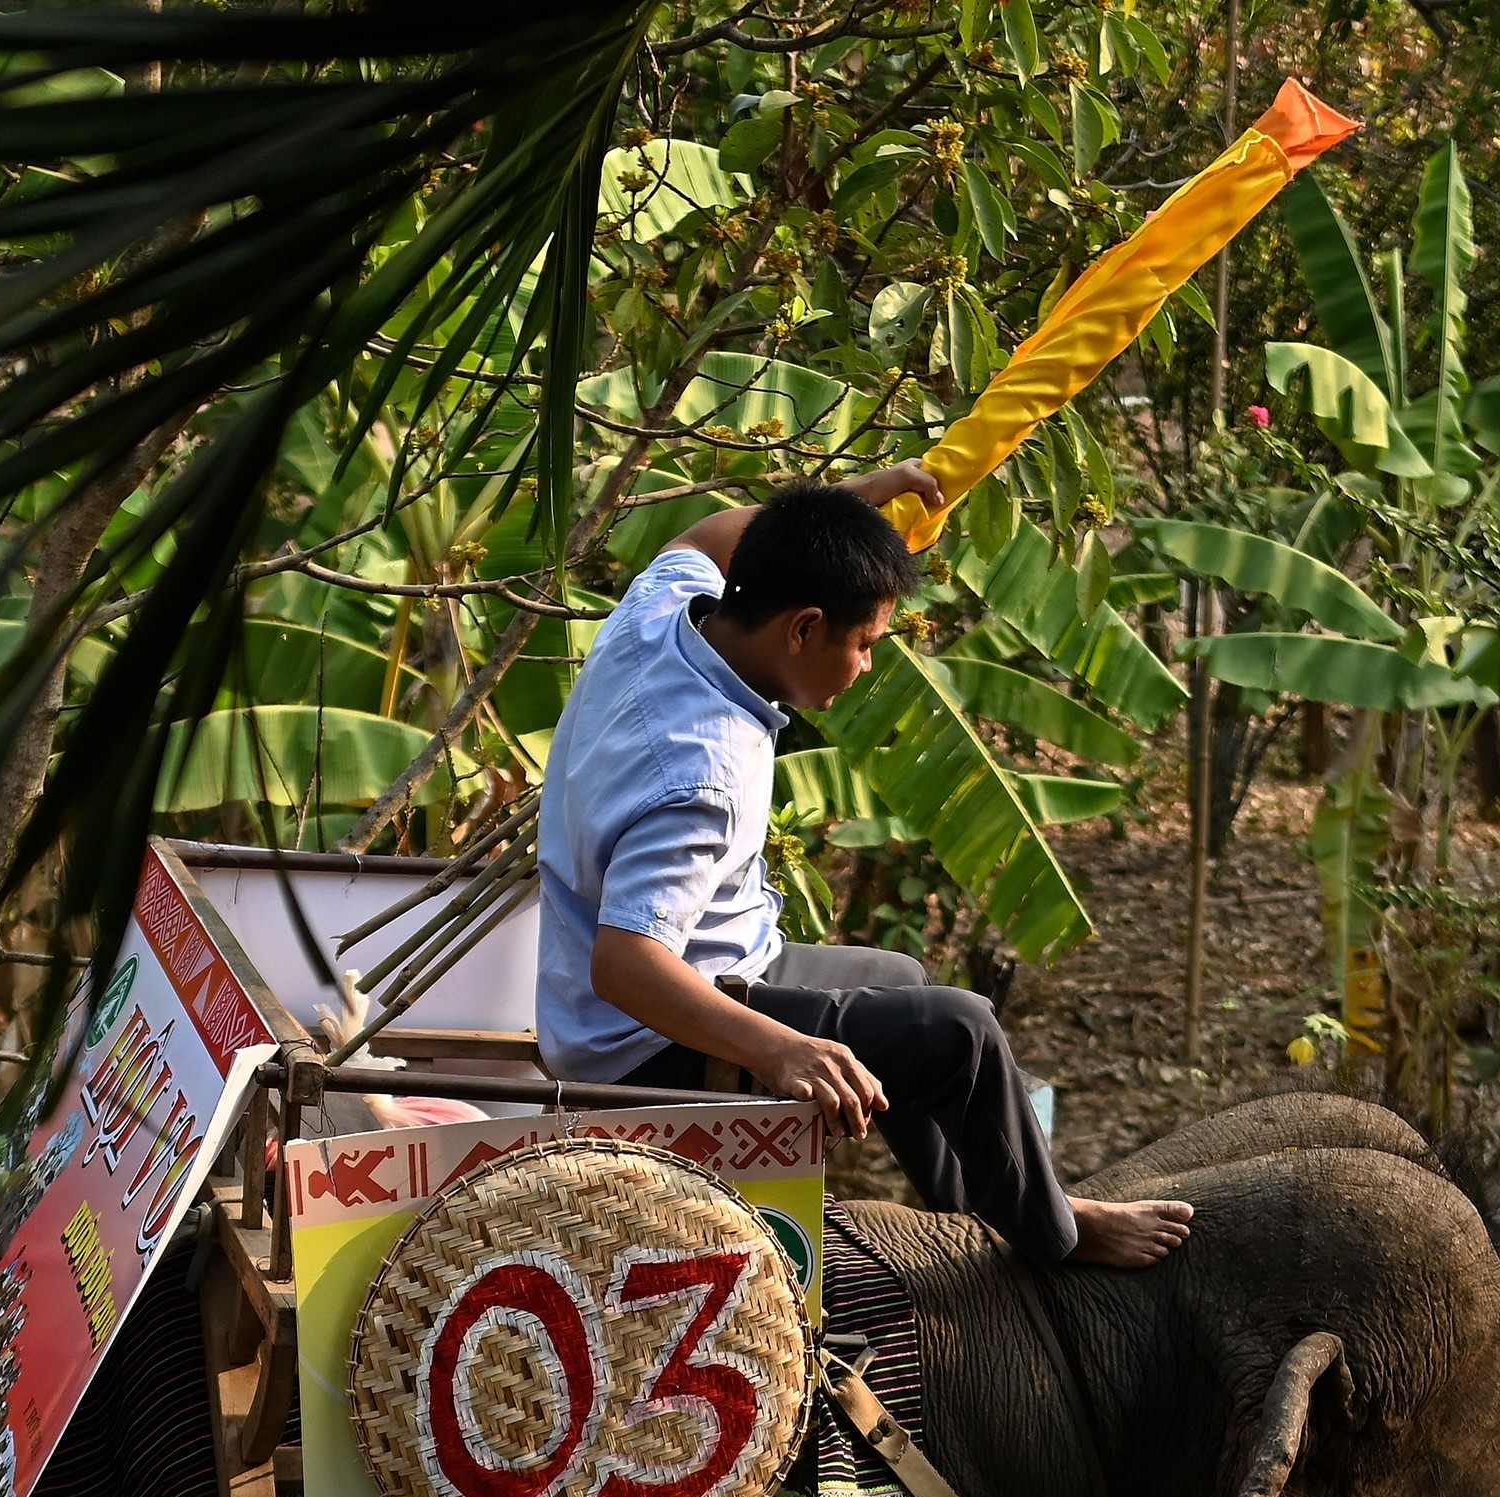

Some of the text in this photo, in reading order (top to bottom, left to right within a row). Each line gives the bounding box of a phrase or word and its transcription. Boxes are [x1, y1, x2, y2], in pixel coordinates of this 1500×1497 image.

[80, 1003, 204, 1273] HỘI VO
[60, 1200, 102, 1279] BUÔN
[77, 1246, 116, 1319] ĐÔN
